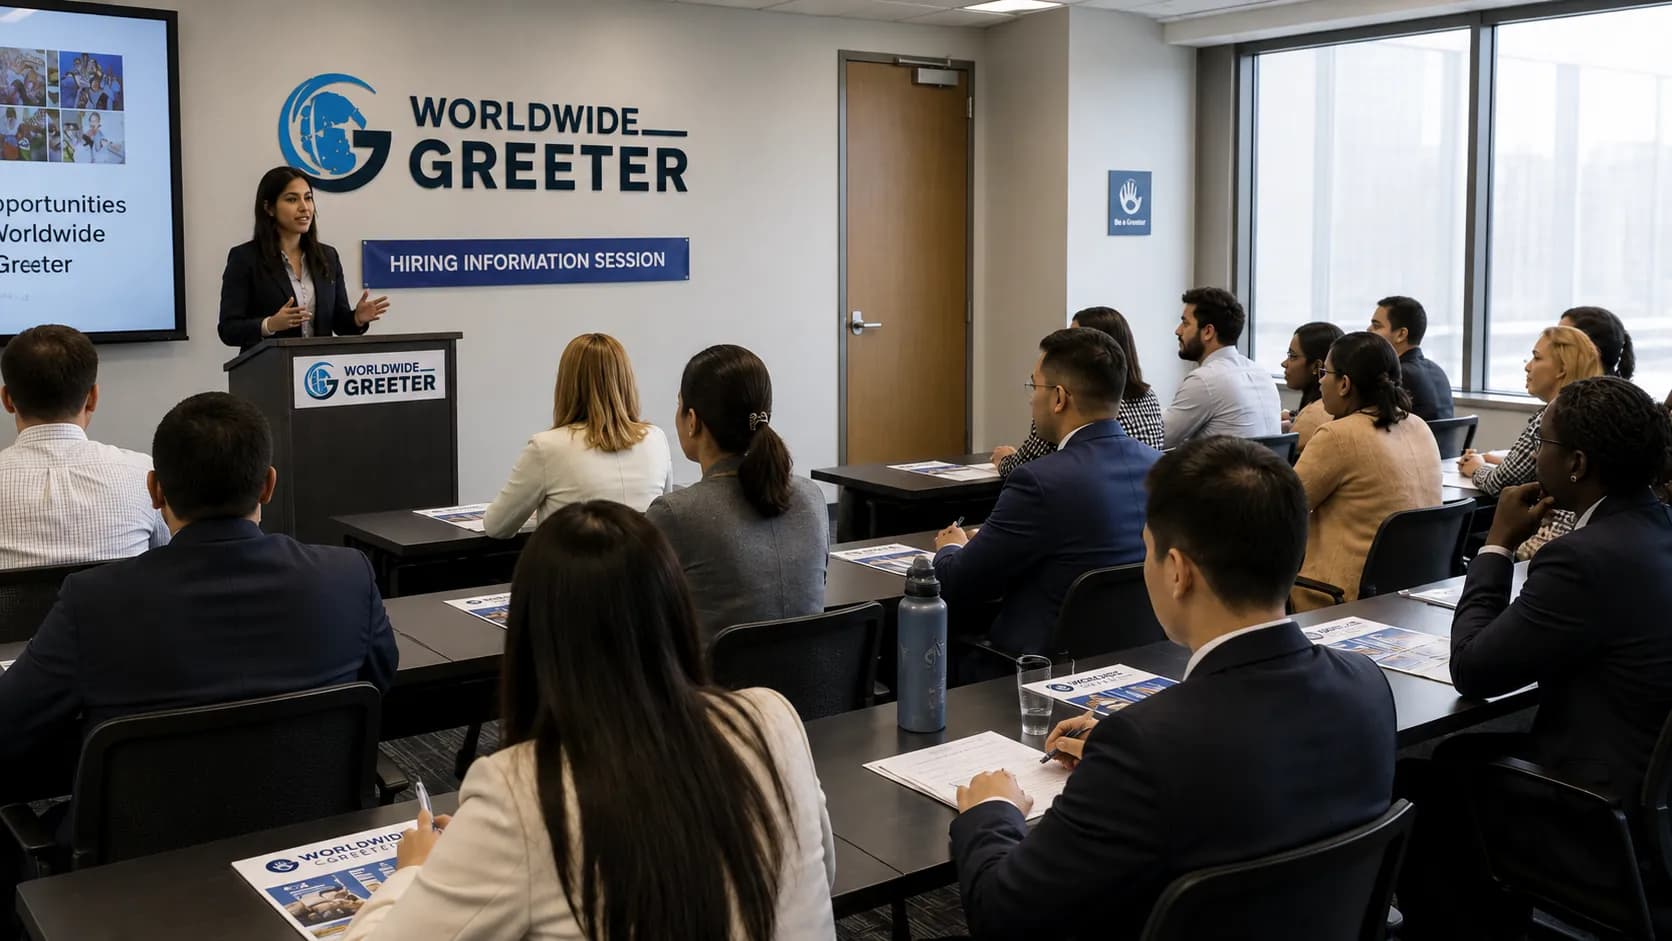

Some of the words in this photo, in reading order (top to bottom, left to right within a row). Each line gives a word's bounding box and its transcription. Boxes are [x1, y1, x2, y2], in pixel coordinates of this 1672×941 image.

[409, 96, 639, 136] WORLDWIDE
[409, 138, 688, 192] GREETER
[0, 254, 73, 274] Greeter
[390, 255, 458, 273] HIRING
[464, 252, 590, 271] INFORMATION
[594, 251, 665, 269] SESSION
[344, 362, 420, 376] WORLDWIDE
[344, 374, 436, 396] GREETER
[298, 831, 405, 861] WORLDWID
